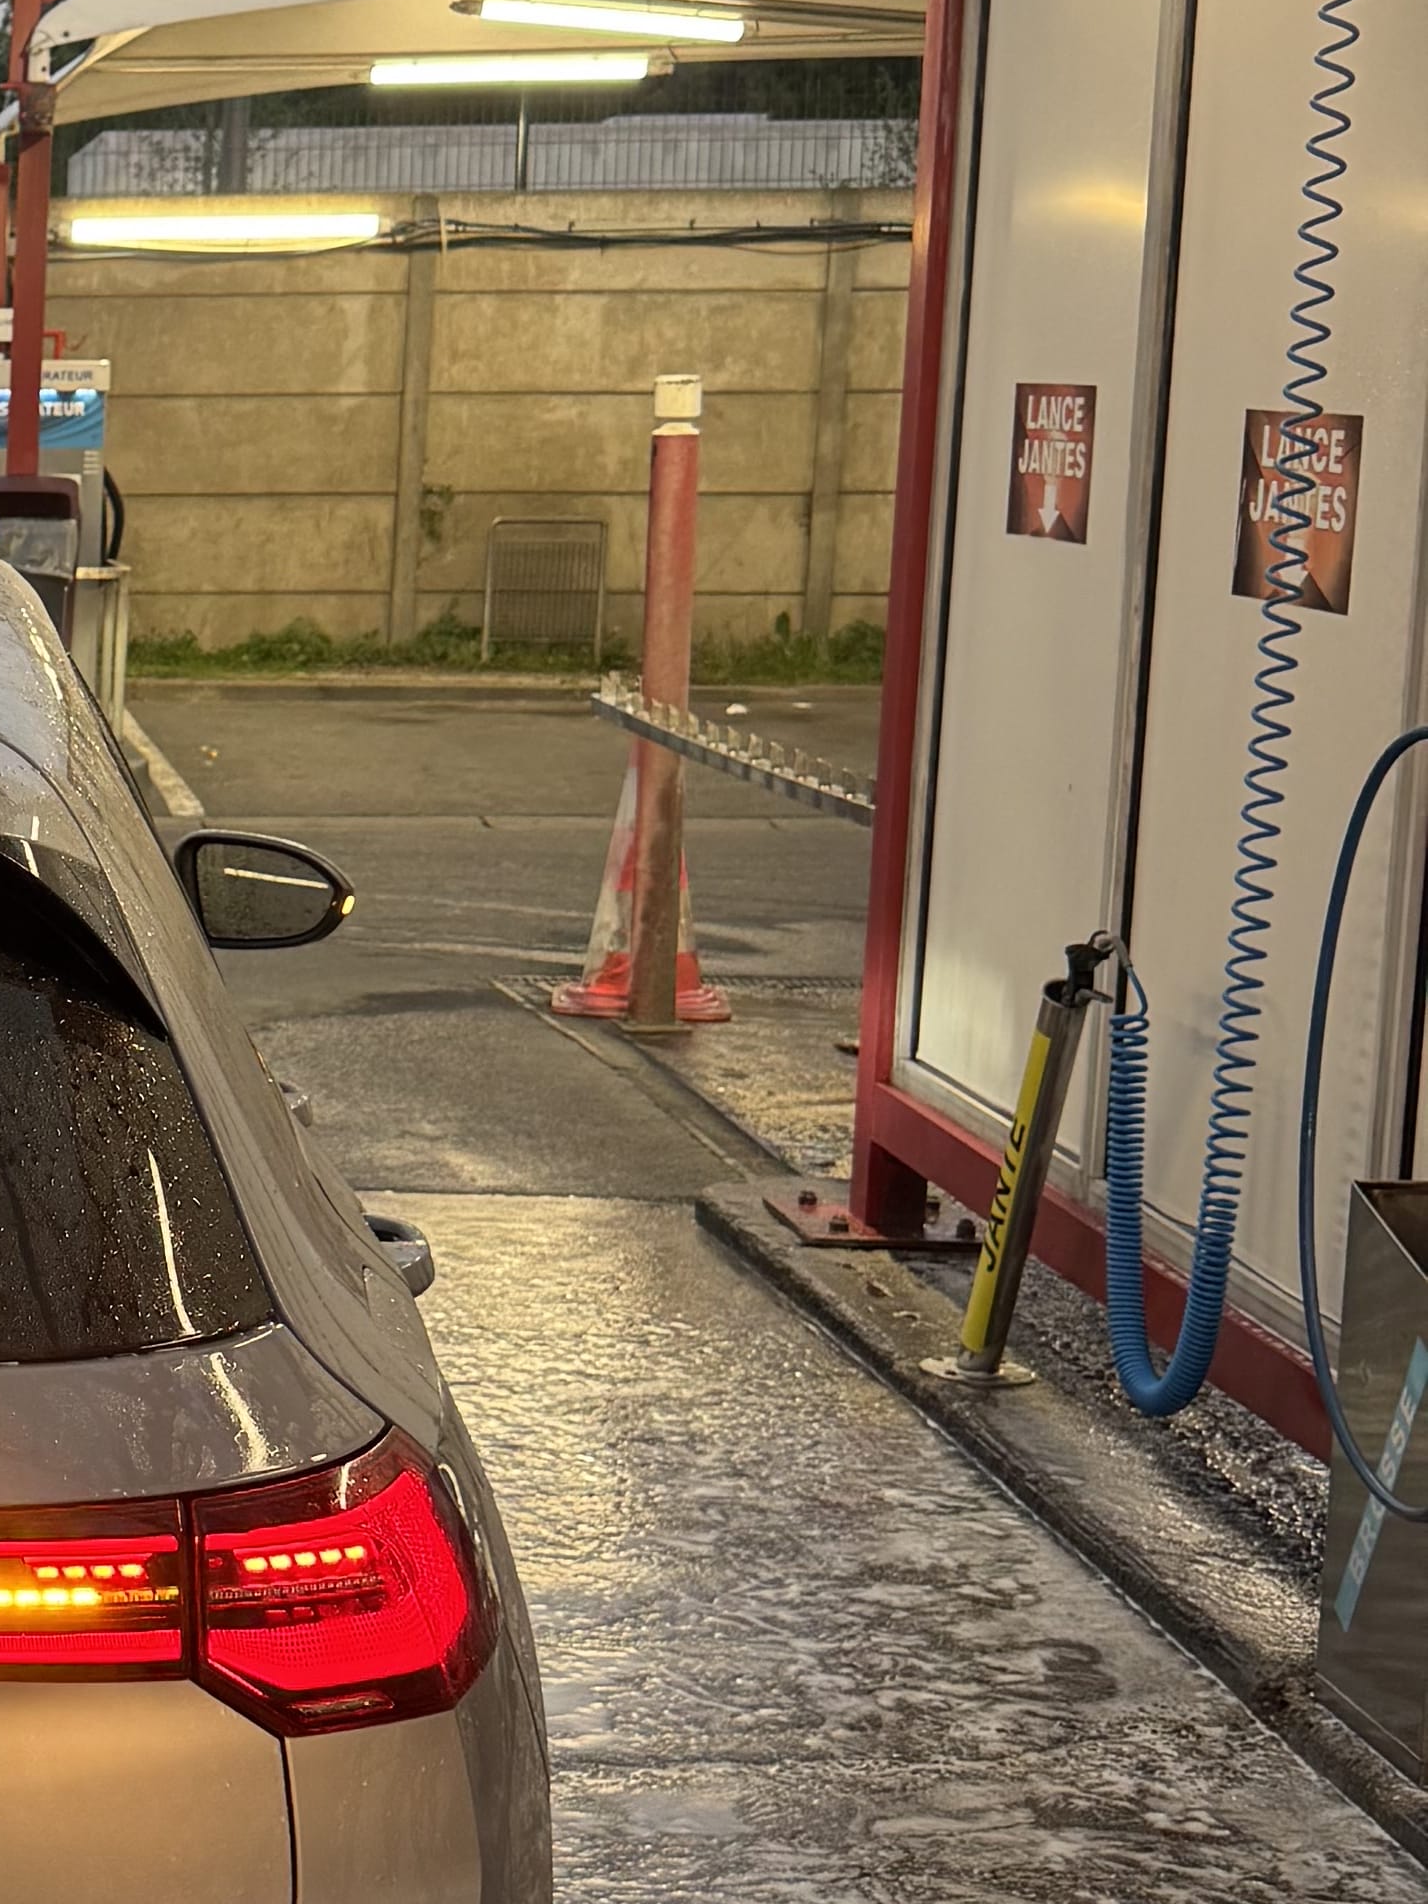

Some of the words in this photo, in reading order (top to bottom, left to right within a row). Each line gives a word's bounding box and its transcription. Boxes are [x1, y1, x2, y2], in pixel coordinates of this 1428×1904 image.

[1026, 395, 1086, 432] LANCE
[1018, 438, 1087, 478] JANTES
[1260, 424, 1346, 475] LANCE
